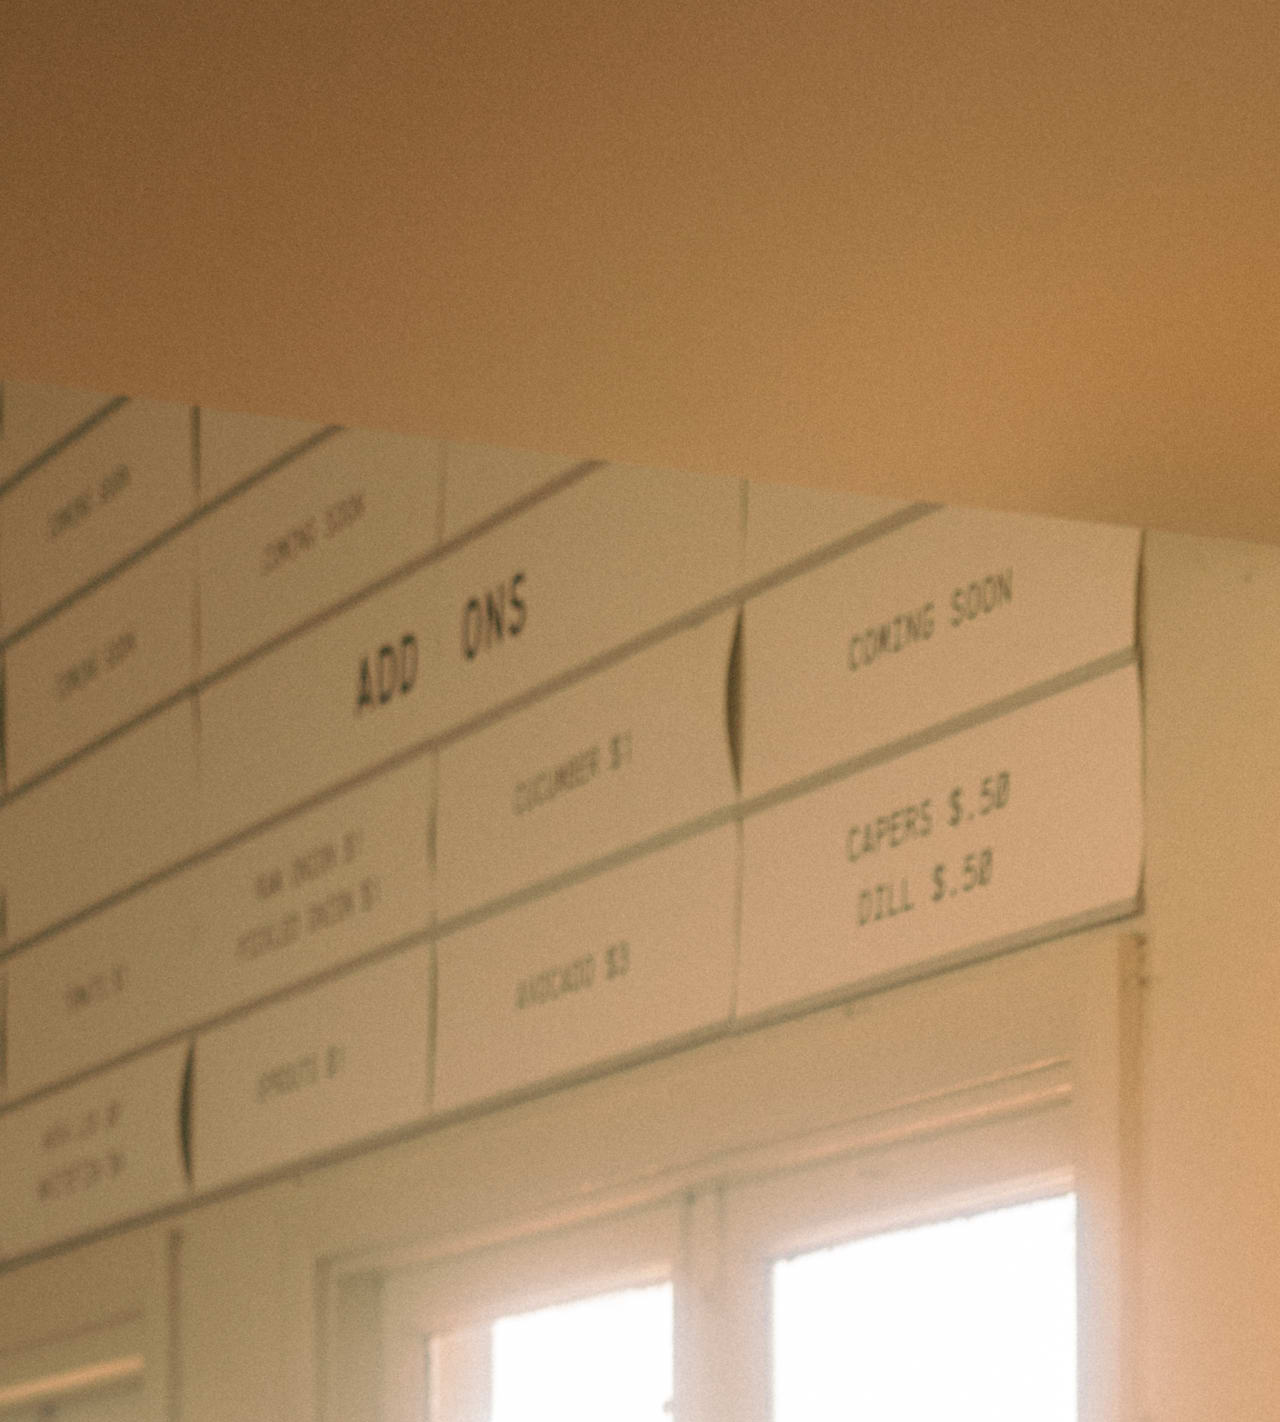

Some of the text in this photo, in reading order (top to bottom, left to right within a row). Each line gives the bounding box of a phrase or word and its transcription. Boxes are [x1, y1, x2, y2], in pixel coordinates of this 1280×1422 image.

[353, 571, 527, 718] ADD ONS
[848, 567, 1013, 673] COMING SOON
[512, 745, 600, 817] CUCUMBER
[846, 771, 1009, 864] CAPERS $.50
[858, 847, 993, 928] DILL $.50
[515, 952, 596, 1010] AVOCADO
